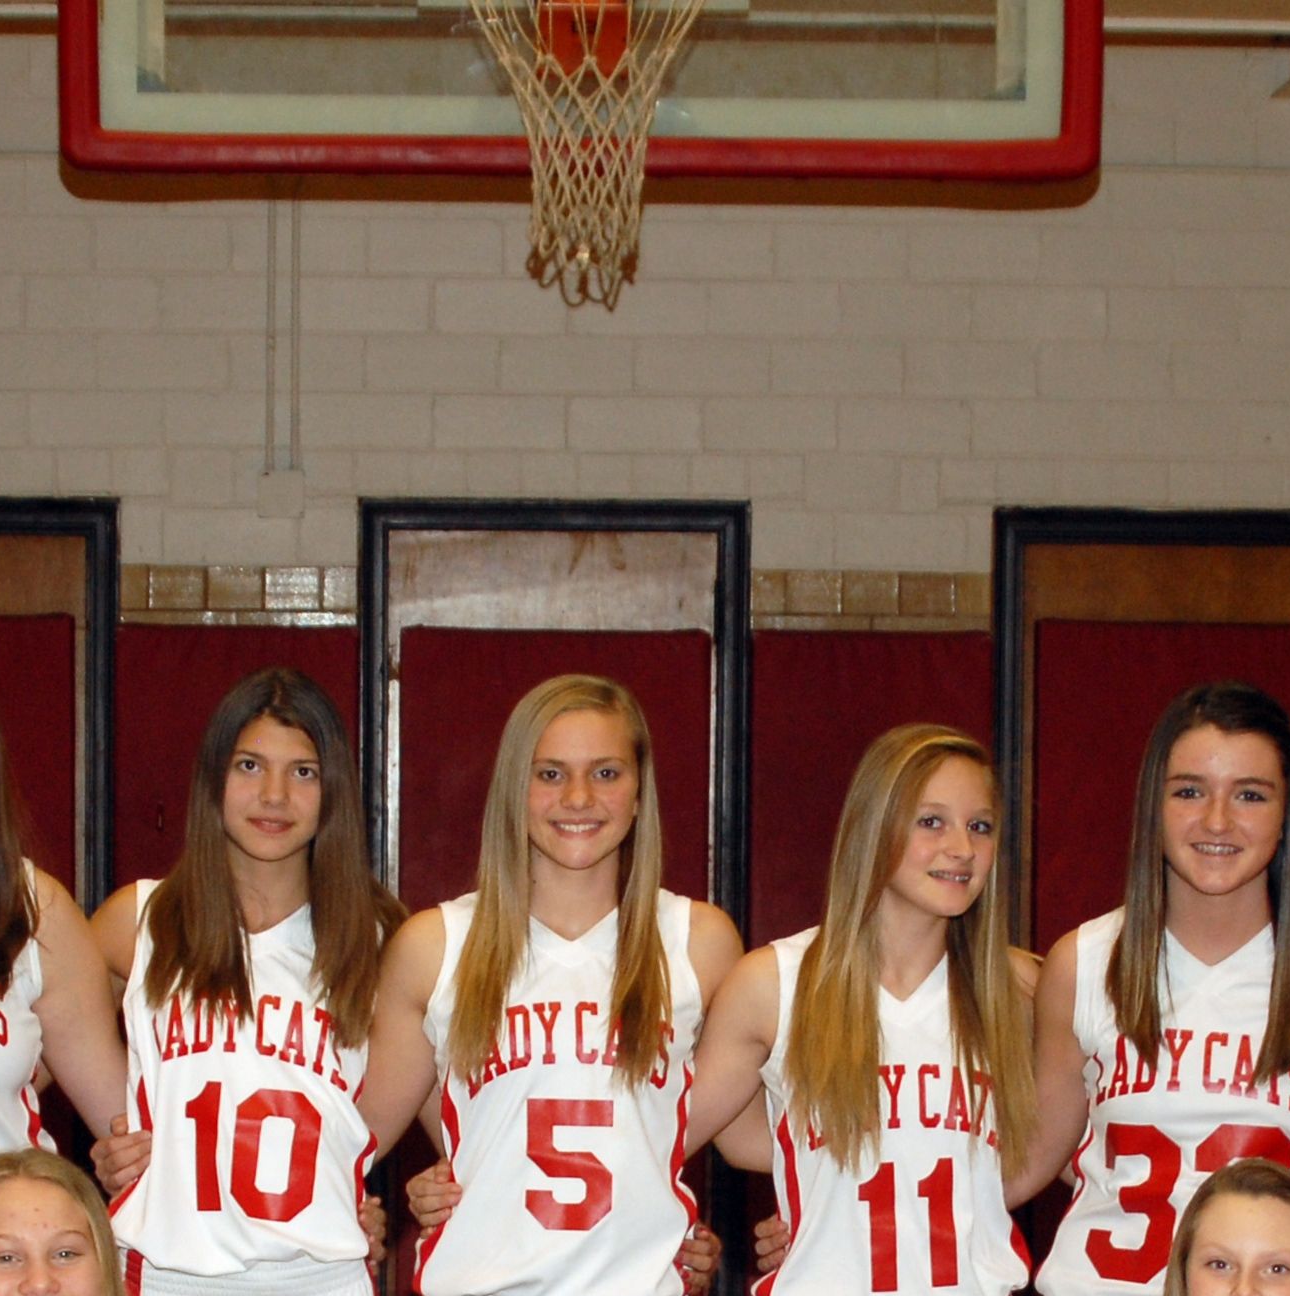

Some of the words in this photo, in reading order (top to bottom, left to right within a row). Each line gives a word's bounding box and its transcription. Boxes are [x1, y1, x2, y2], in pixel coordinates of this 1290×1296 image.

[466, 1002, 561, 1100] ADY
[575, 1001, 674, 1090] CAS
[918, 1063, 999, 1150] CAT
[185, 1081, 322, 1222] 10
[525, 1098, 614, 1231] 5
[858, 1157, 959, 1293] 11
